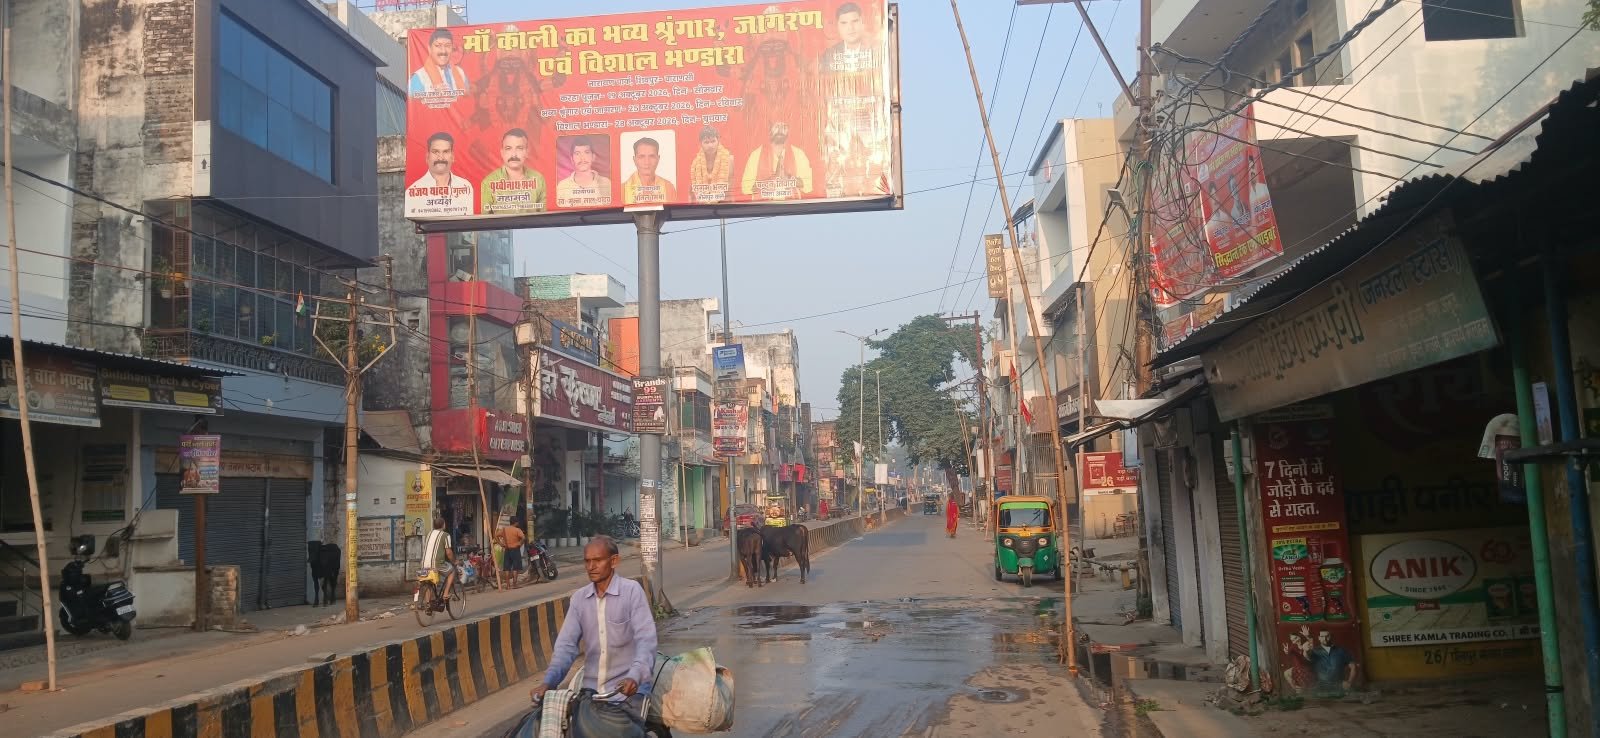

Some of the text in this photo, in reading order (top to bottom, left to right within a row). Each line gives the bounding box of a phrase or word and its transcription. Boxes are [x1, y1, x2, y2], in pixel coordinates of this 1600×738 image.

[496, 24, 559, 51] काली
[564, 27, 597, 47] का
[602, 22, 649, 45] भव्य
[732, 10, 825, 36] जागरण
[537, 45, 745, 77] एवं विशाल भण्डारा
[665, 73, 695, 84] वाराणसी
[693, 84, 724, 96] सोमवार
[717, 97, 744, 108] रविवार
[702, 113, 729, 124] बुधवार
[408, 186, 429, 198] संजय
[430, 185, 449, 196] यादव
[496, 191, 531, 202] महामंत्री
[426, 196, 452, 206] अध्यक्ष
[633, 378, 666, 388] Brands
[643, 386, 657, 394] 99
[1264, 455, 1324, 479] 7 दिनों में
[1266, 474, 1335, 501] जोड़ों के दर्द
[1268, 500, 1320, 518] से राहत.
[1384, 558, 1464, 580] ANIK
[1383, 633, 1413, 644] SHREE
[1414, 631, 1448, 642] KAMLA
[1449, 630, 1492, 641] TRADING
